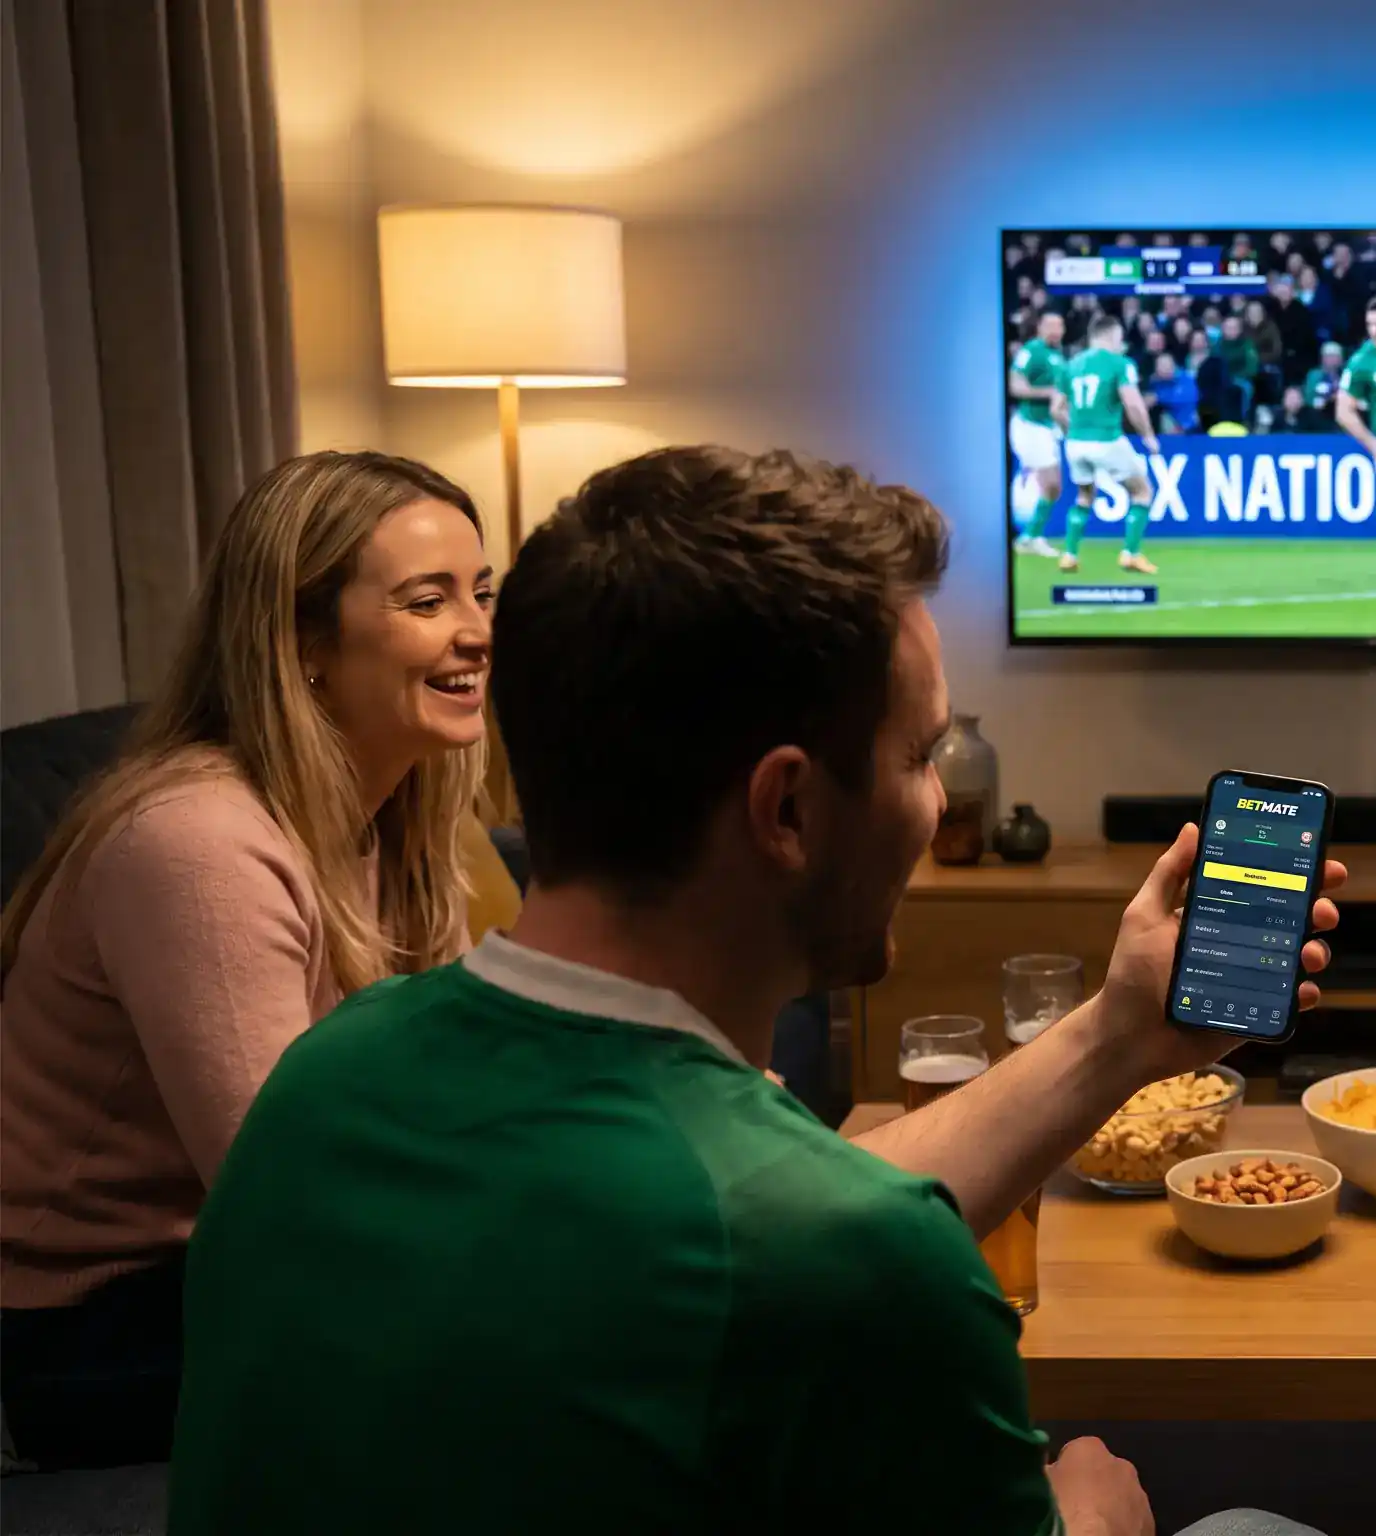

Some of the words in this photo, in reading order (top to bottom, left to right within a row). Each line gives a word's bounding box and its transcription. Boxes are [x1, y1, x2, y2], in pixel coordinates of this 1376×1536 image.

[1072, 375, 1099, 408] 17
[1093, 454, 1189, 522] SX
[1236, 798, 1299, 817] BETMATE
